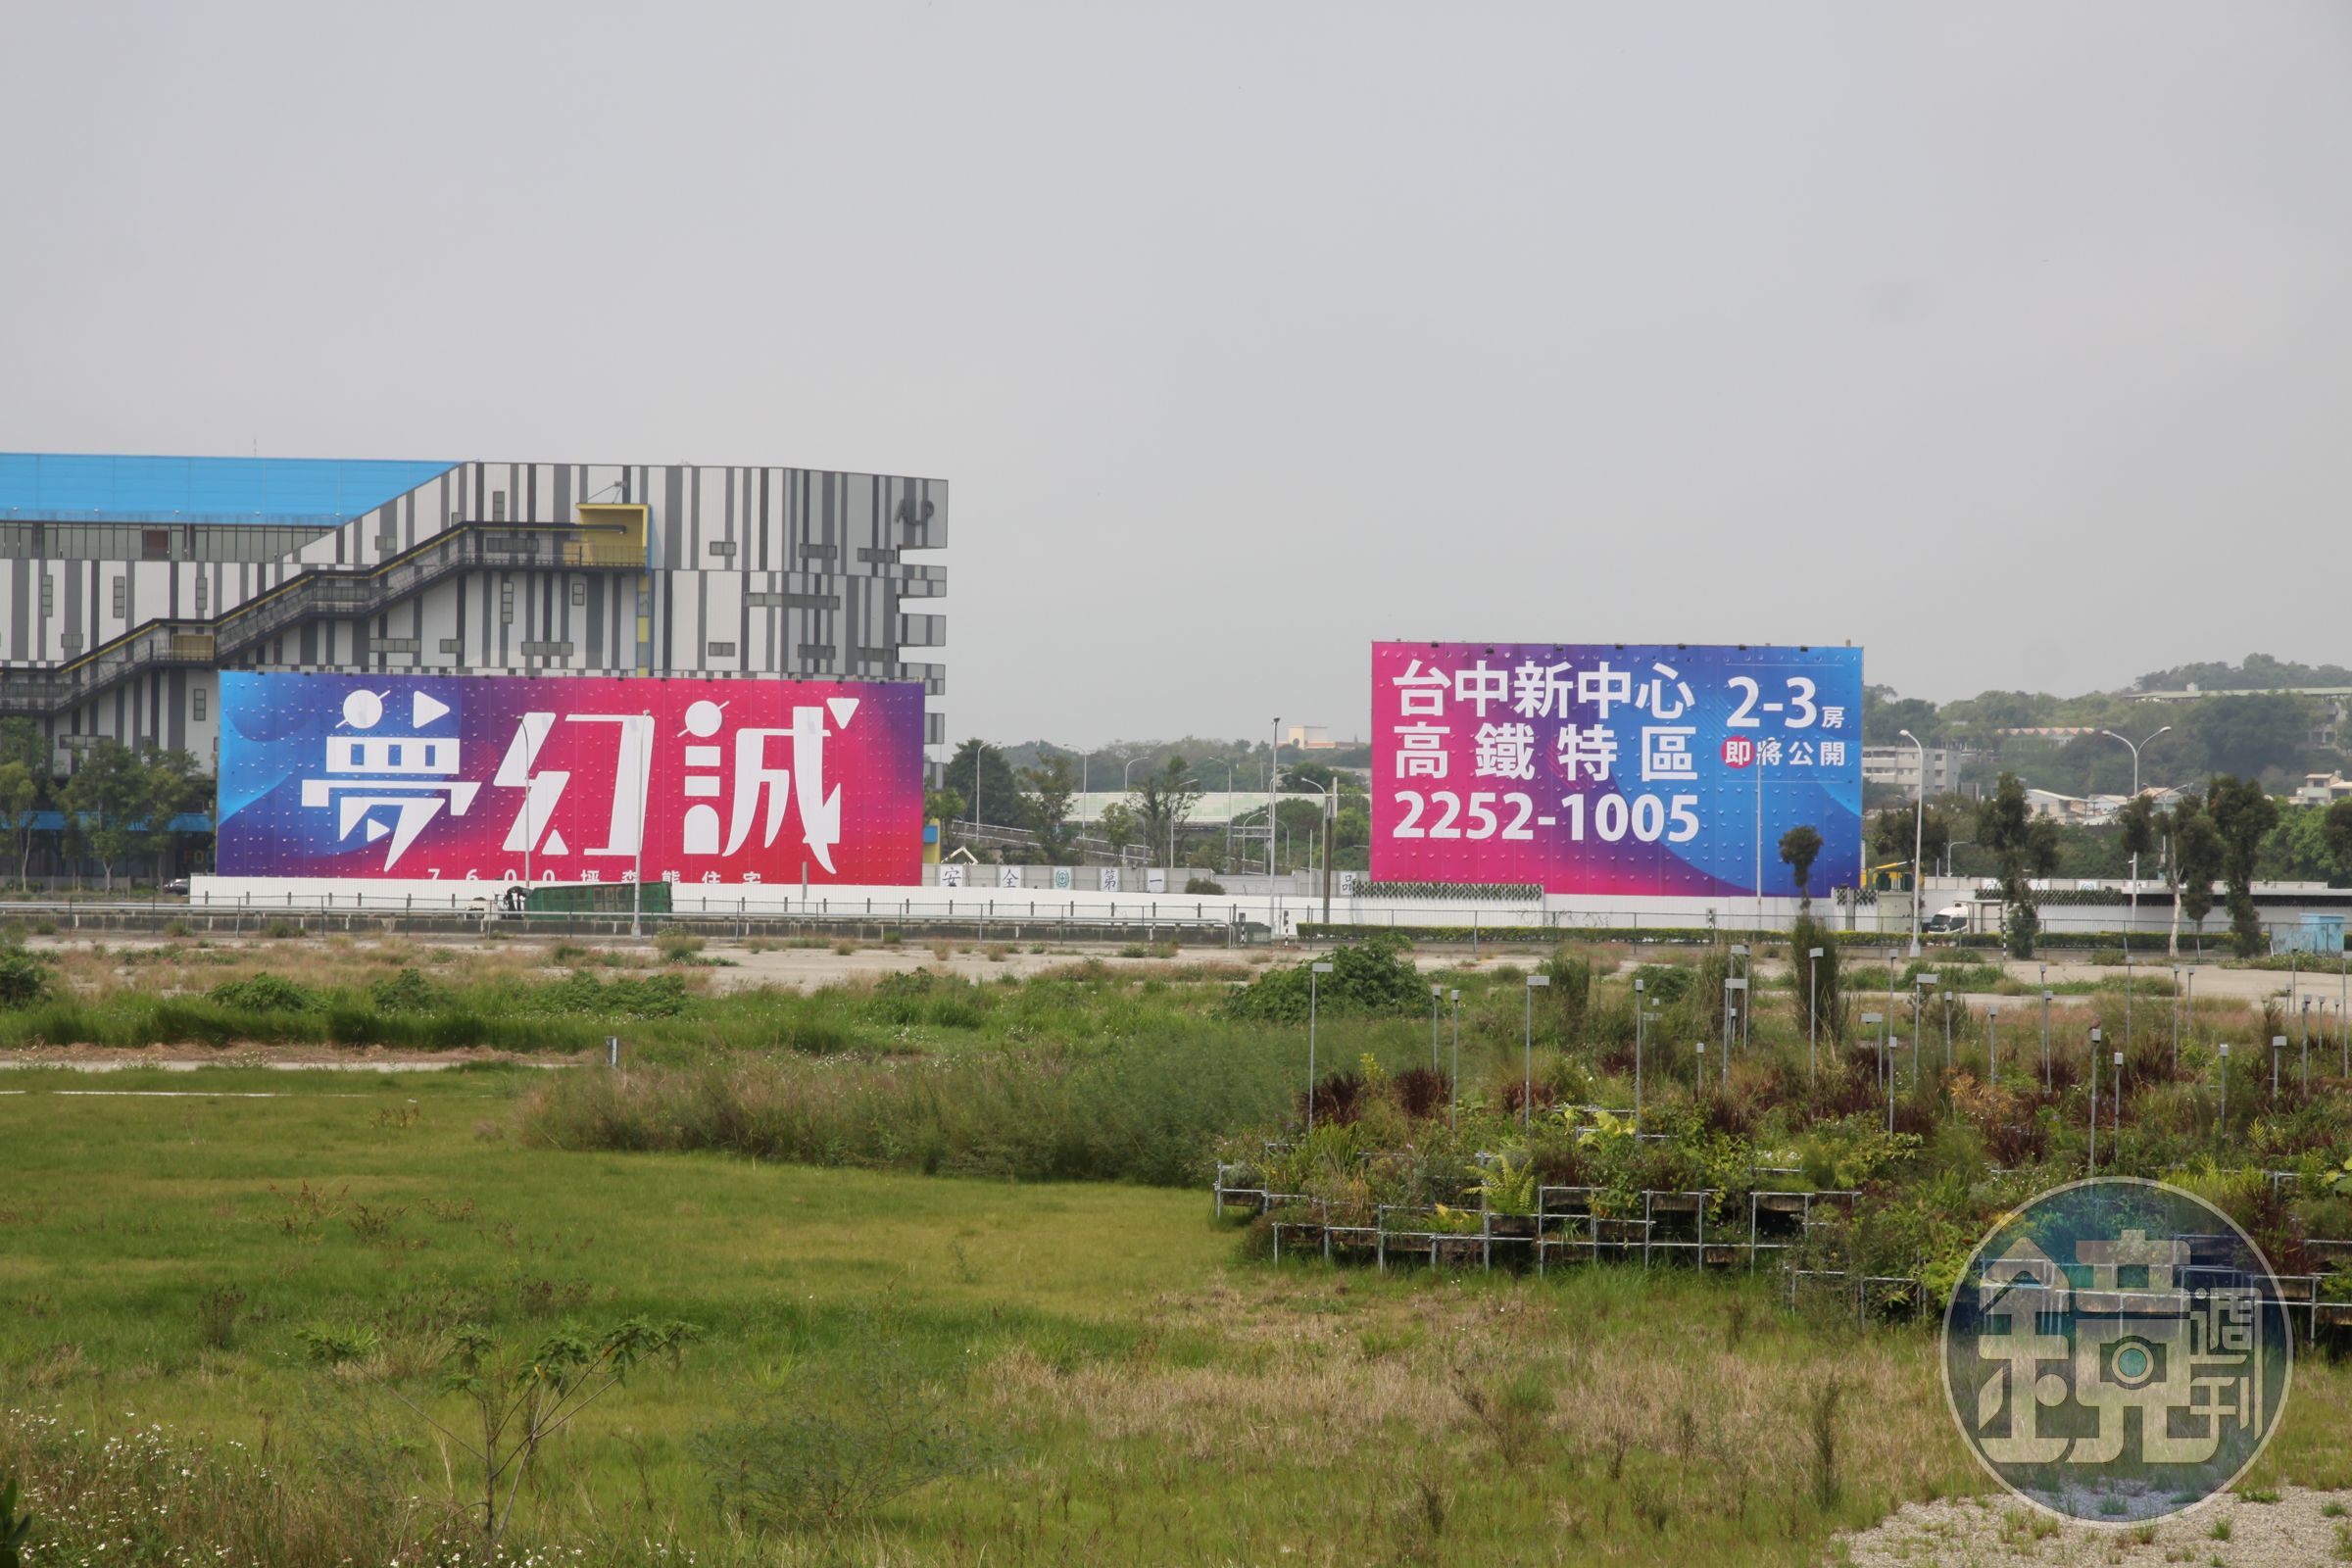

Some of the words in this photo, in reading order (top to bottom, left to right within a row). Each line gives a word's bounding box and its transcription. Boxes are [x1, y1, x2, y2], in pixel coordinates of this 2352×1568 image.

[1393, 659, 1696, 719] 台中新中心
[302, 688, 860, 874] 夢幻誠
[1393, 721, 1698, 782] 高鐵特區
[1725, 741, 1845, 766] 即將公開
[1393, 791, 1699, 843] 2252-1005
